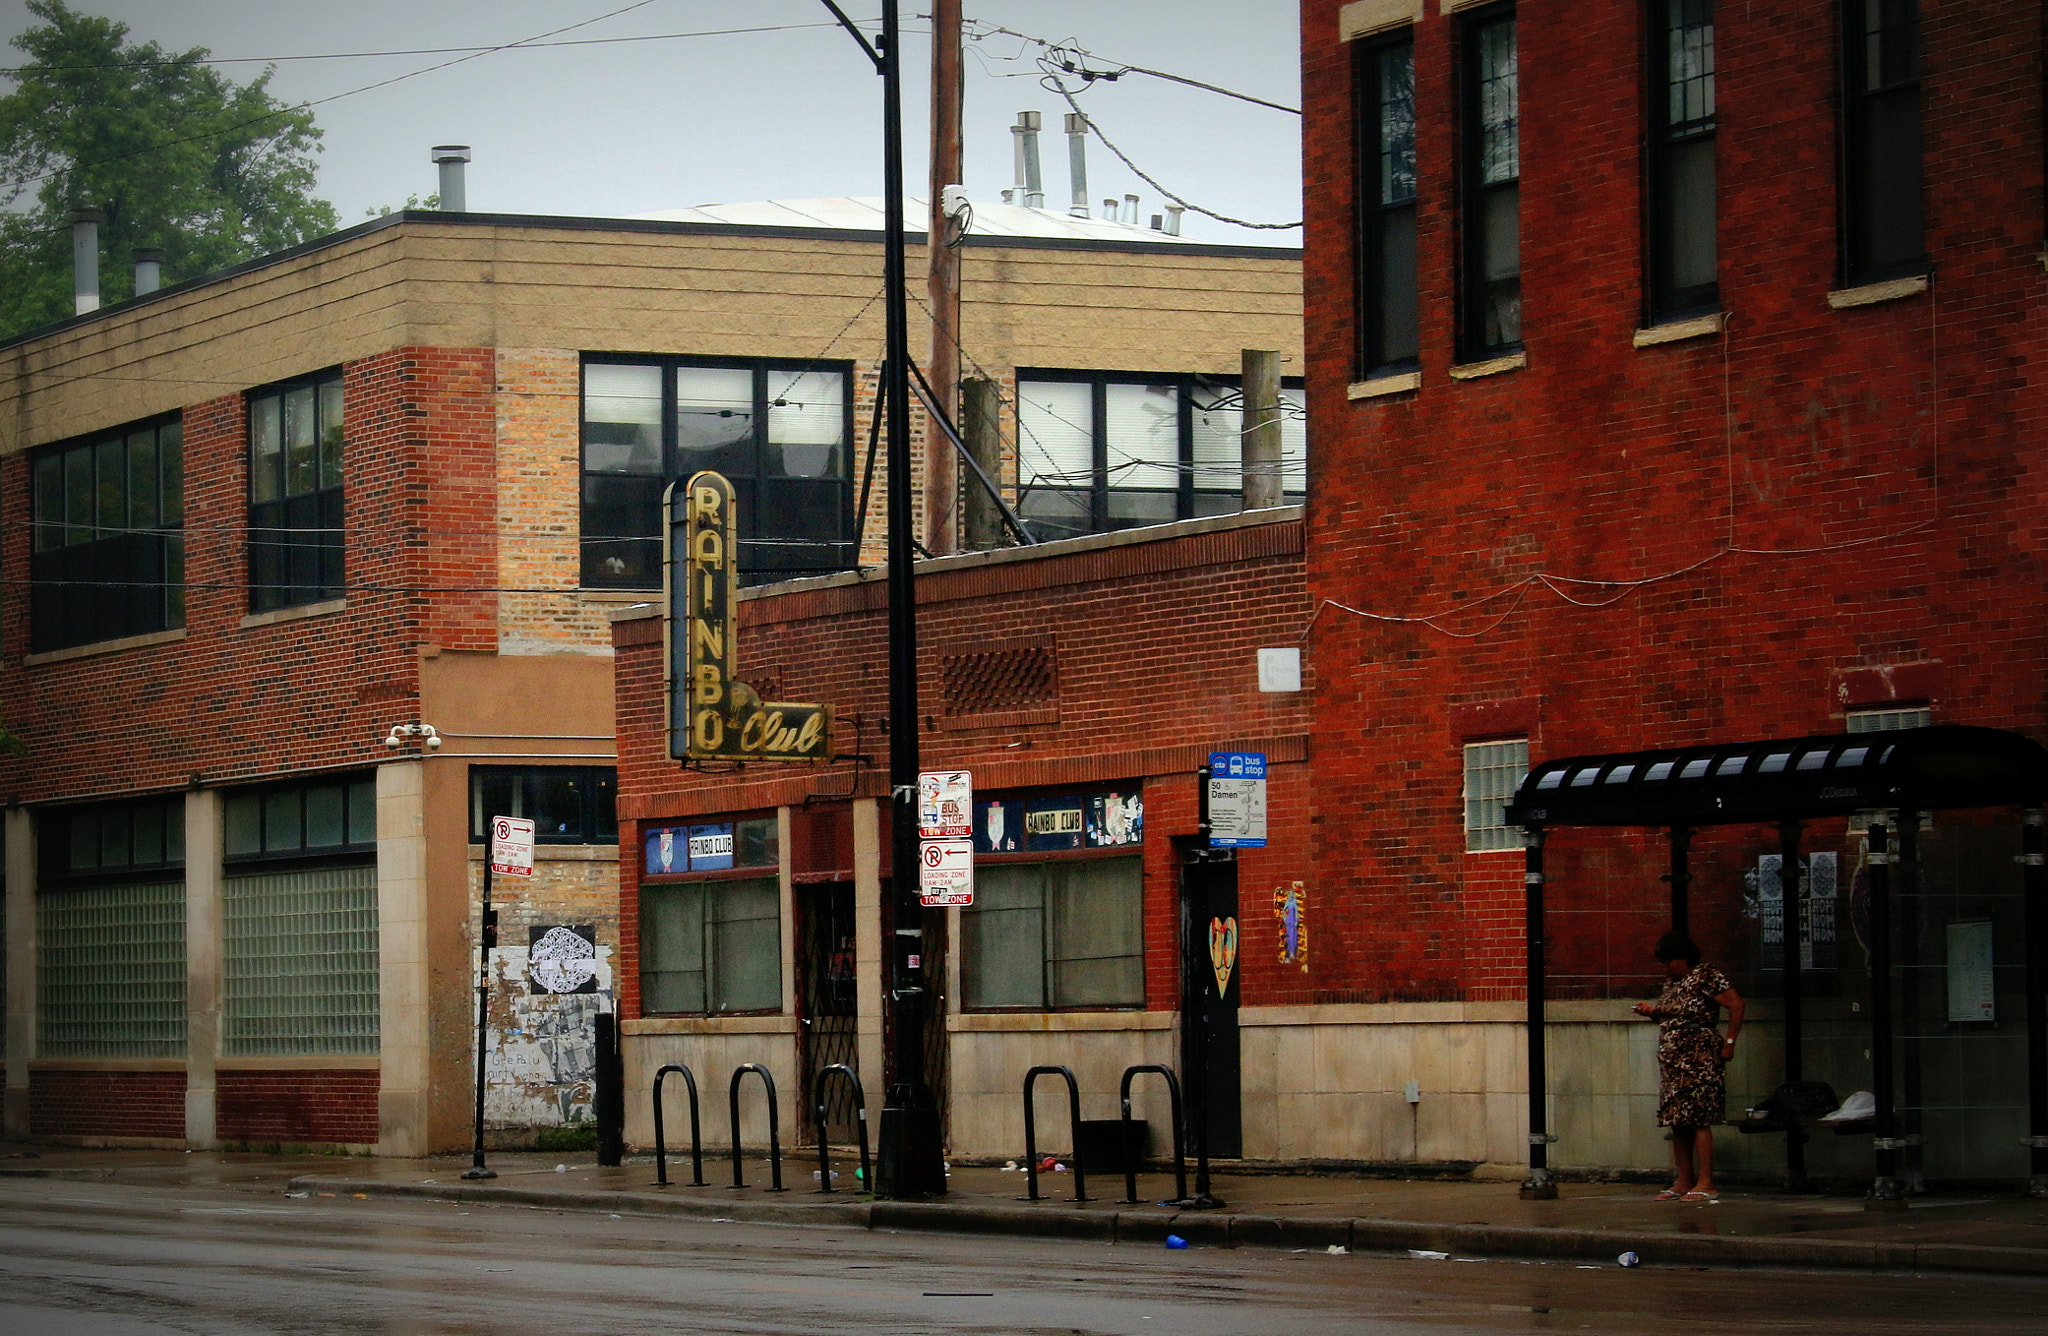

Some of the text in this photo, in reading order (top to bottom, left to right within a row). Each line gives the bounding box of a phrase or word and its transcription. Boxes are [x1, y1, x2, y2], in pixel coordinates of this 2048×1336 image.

[695, 486, 724, 751] RAINBO
[741, 711, 825, 753] Club
[1214, 761, 1226, 769] cta
[1245, 756, 1261, 766] bus
[1244, 765, 1264, 777] stop
[1211, 781, 1221, 790] 50
[1211, 790, 1239, 799] Damen
[941, 802, 960, 814] BUS
[941, 813, 965, 824] STOP
[1028, 813, 1056, 832] RAINBO
[945, 826, 968, 835] ZONE
[690, 837, 732, 856] RAINBO CLUB
[495, 864, 529, 874] TOW ZONE
[924, 870, 966, 879] LOADING ZONE
[946, 894, 968, 904] ZONE
